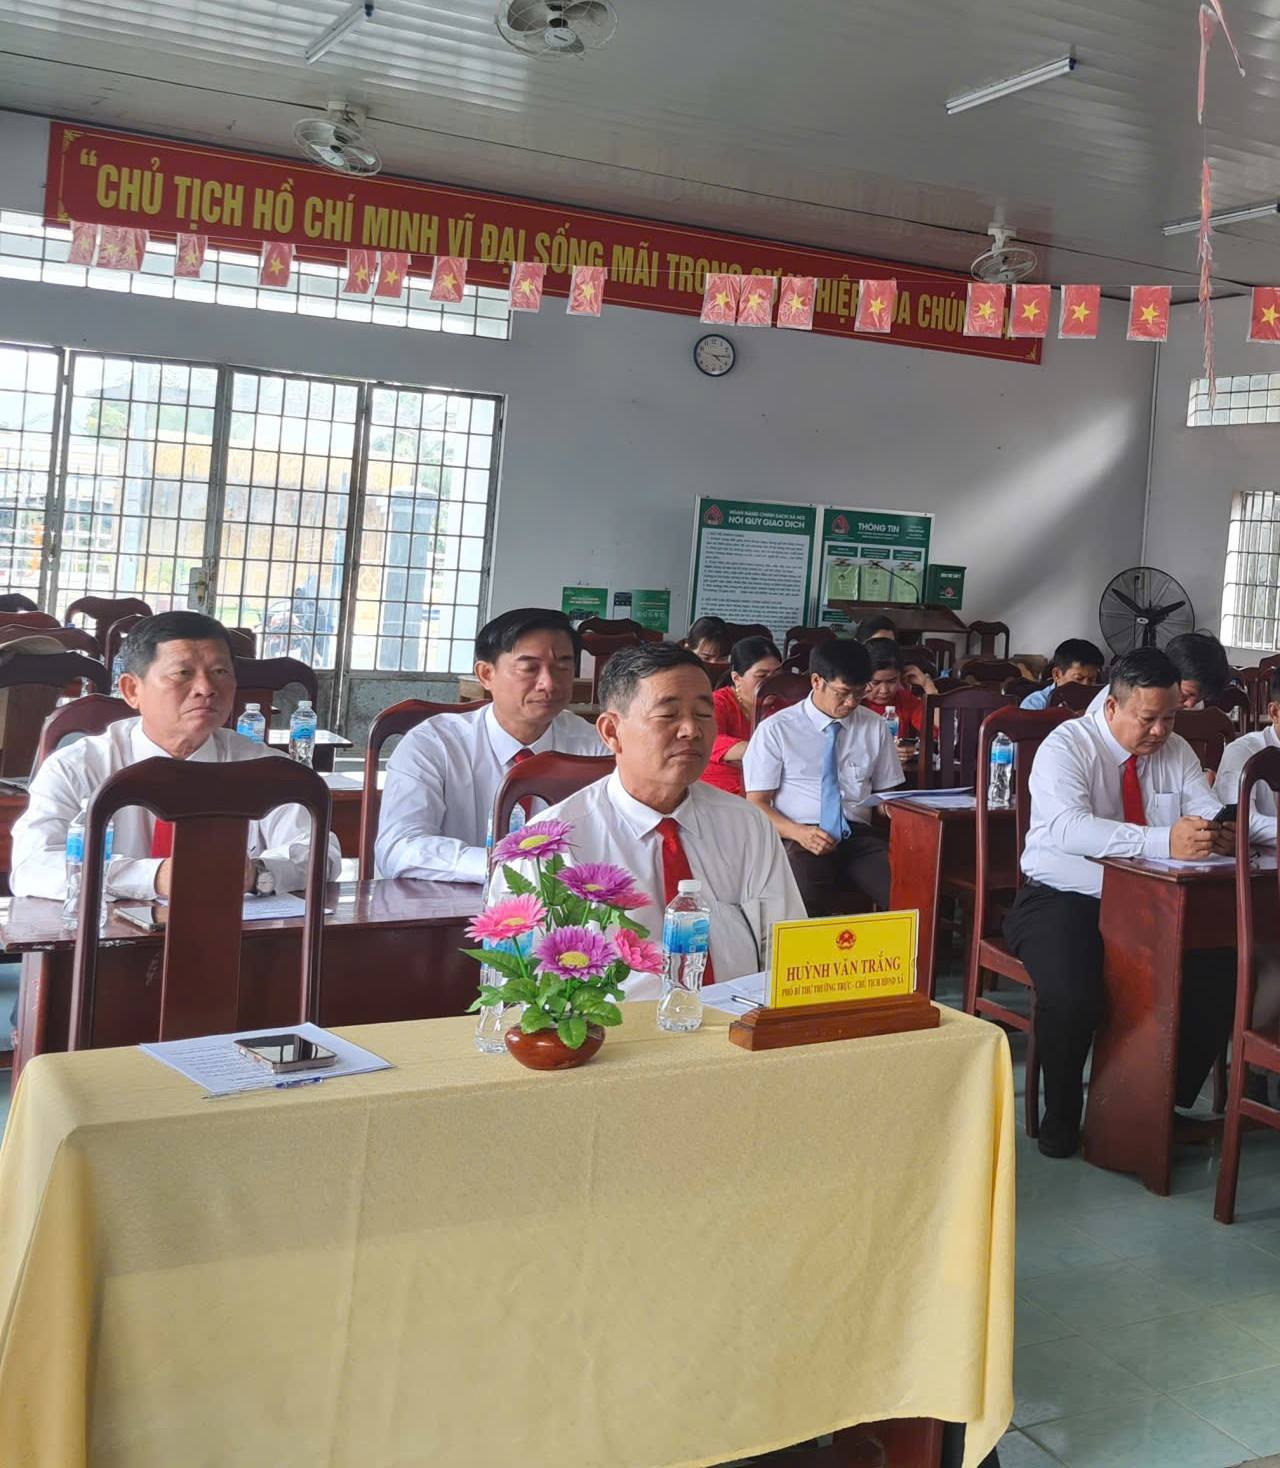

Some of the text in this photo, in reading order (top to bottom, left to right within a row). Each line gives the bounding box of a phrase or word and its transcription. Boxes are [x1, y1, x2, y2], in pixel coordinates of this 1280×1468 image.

[174, 176, 243, 231] TỊCH
[253, 178, 295, 234] HỒ
[304, 194, 353, 243] CHÍ
[363, 207, 439, 257] MINH
[448, 213, 476, 262] VĨ
[481, 223, 527, 274] ĐẠI
[533, 222, 604, 275] SỐNG
[611, 241, 659, 288] MÃI
[786, 951, 901, 982] HUỲNH VĂN TRẮNG
